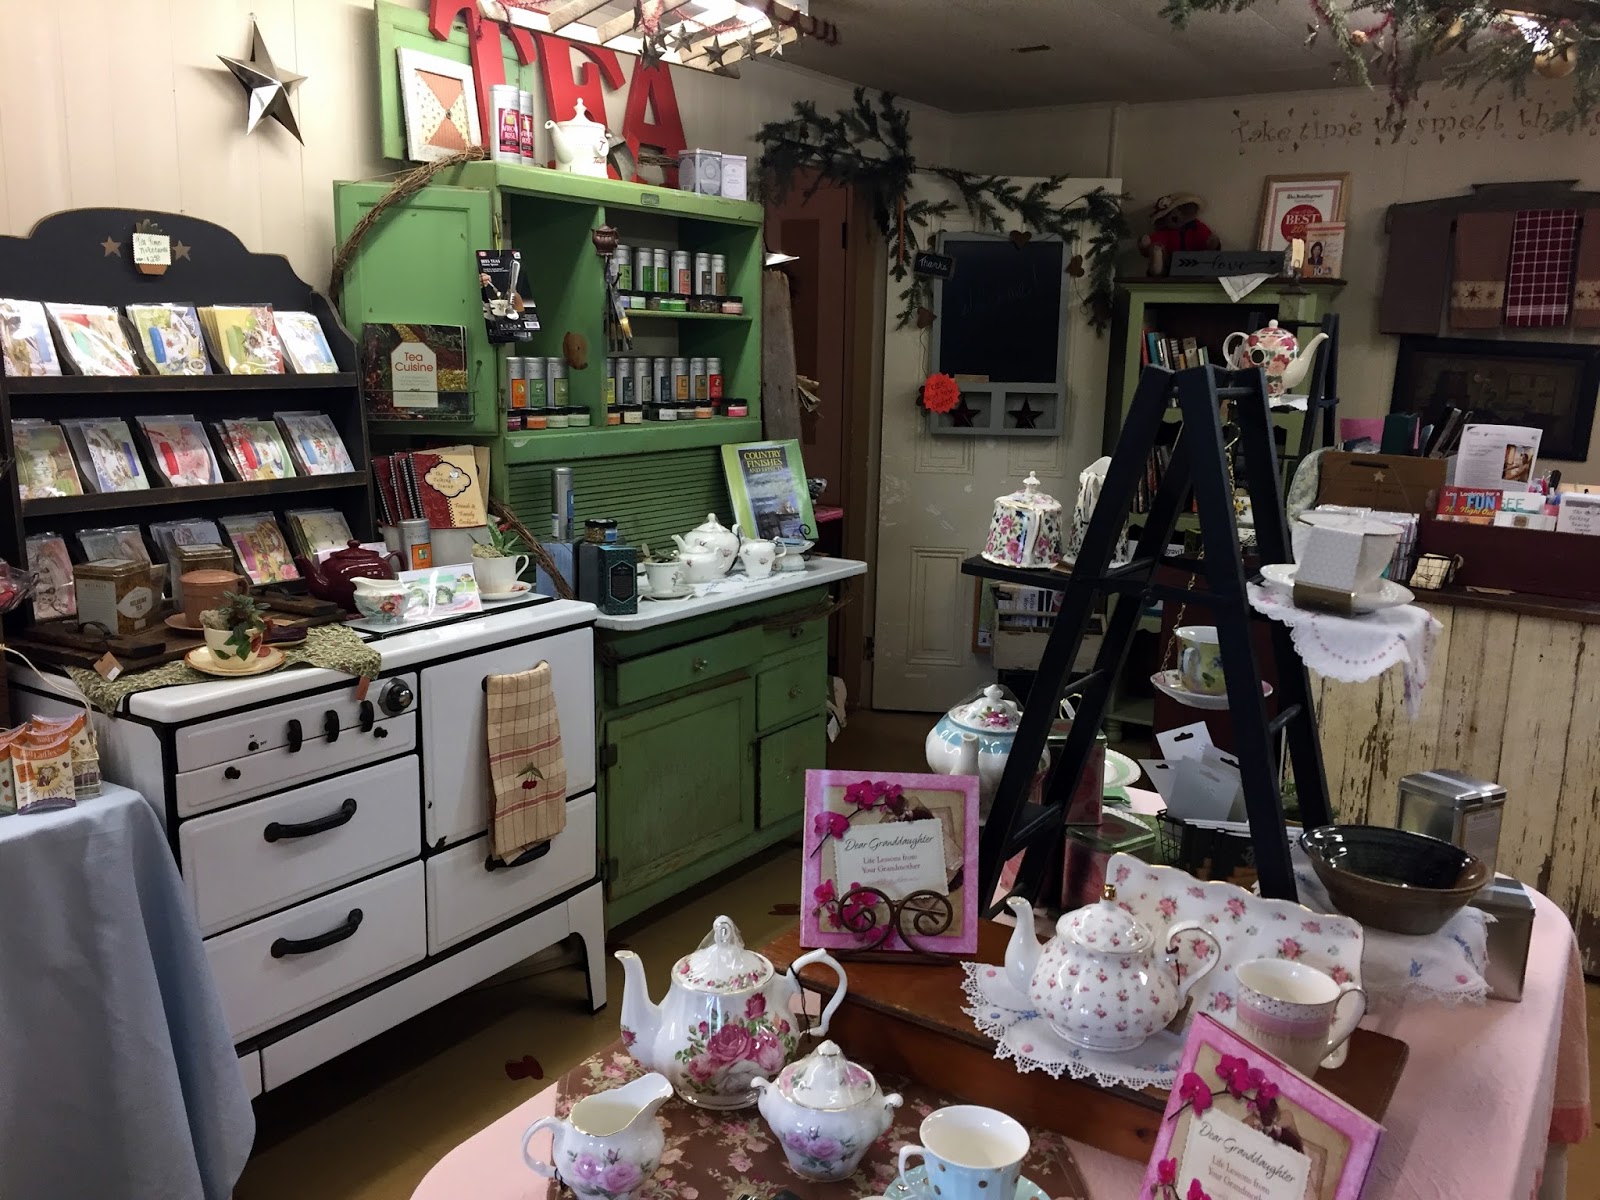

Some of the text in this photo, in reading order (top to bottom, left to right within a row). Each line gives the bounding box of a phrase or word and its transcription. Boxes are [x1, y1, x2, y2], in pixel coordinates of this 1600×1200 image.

[429, 0, 687, 188] TEA
[1231, 119, 1291, 143] Take
[1299, 119, 1362, 140] time
[1415, 104, 1505, 133] smell
[1285, 213, 1321, 225] BEST
[404, 351, 423, 362] Tea
[394, 361, 434, 372] Cuisine
[743, 450, 781, 461] COUNTRY
[746, 458, 783, 468] FINISHES
[1466, 494, 1496, 510] FUN
[1460, 506, 1481, 515] Night
[844, 833, 934, 852] Dear Granddaughter
[877, 863, 921, 872] Grandmother
[1199, 1120, 1296, 1183] Dear Granddaughter
[1208, 1165, 1223, 1182] Your
[1212, 1155, 1270, 1195] Life Lessons from
